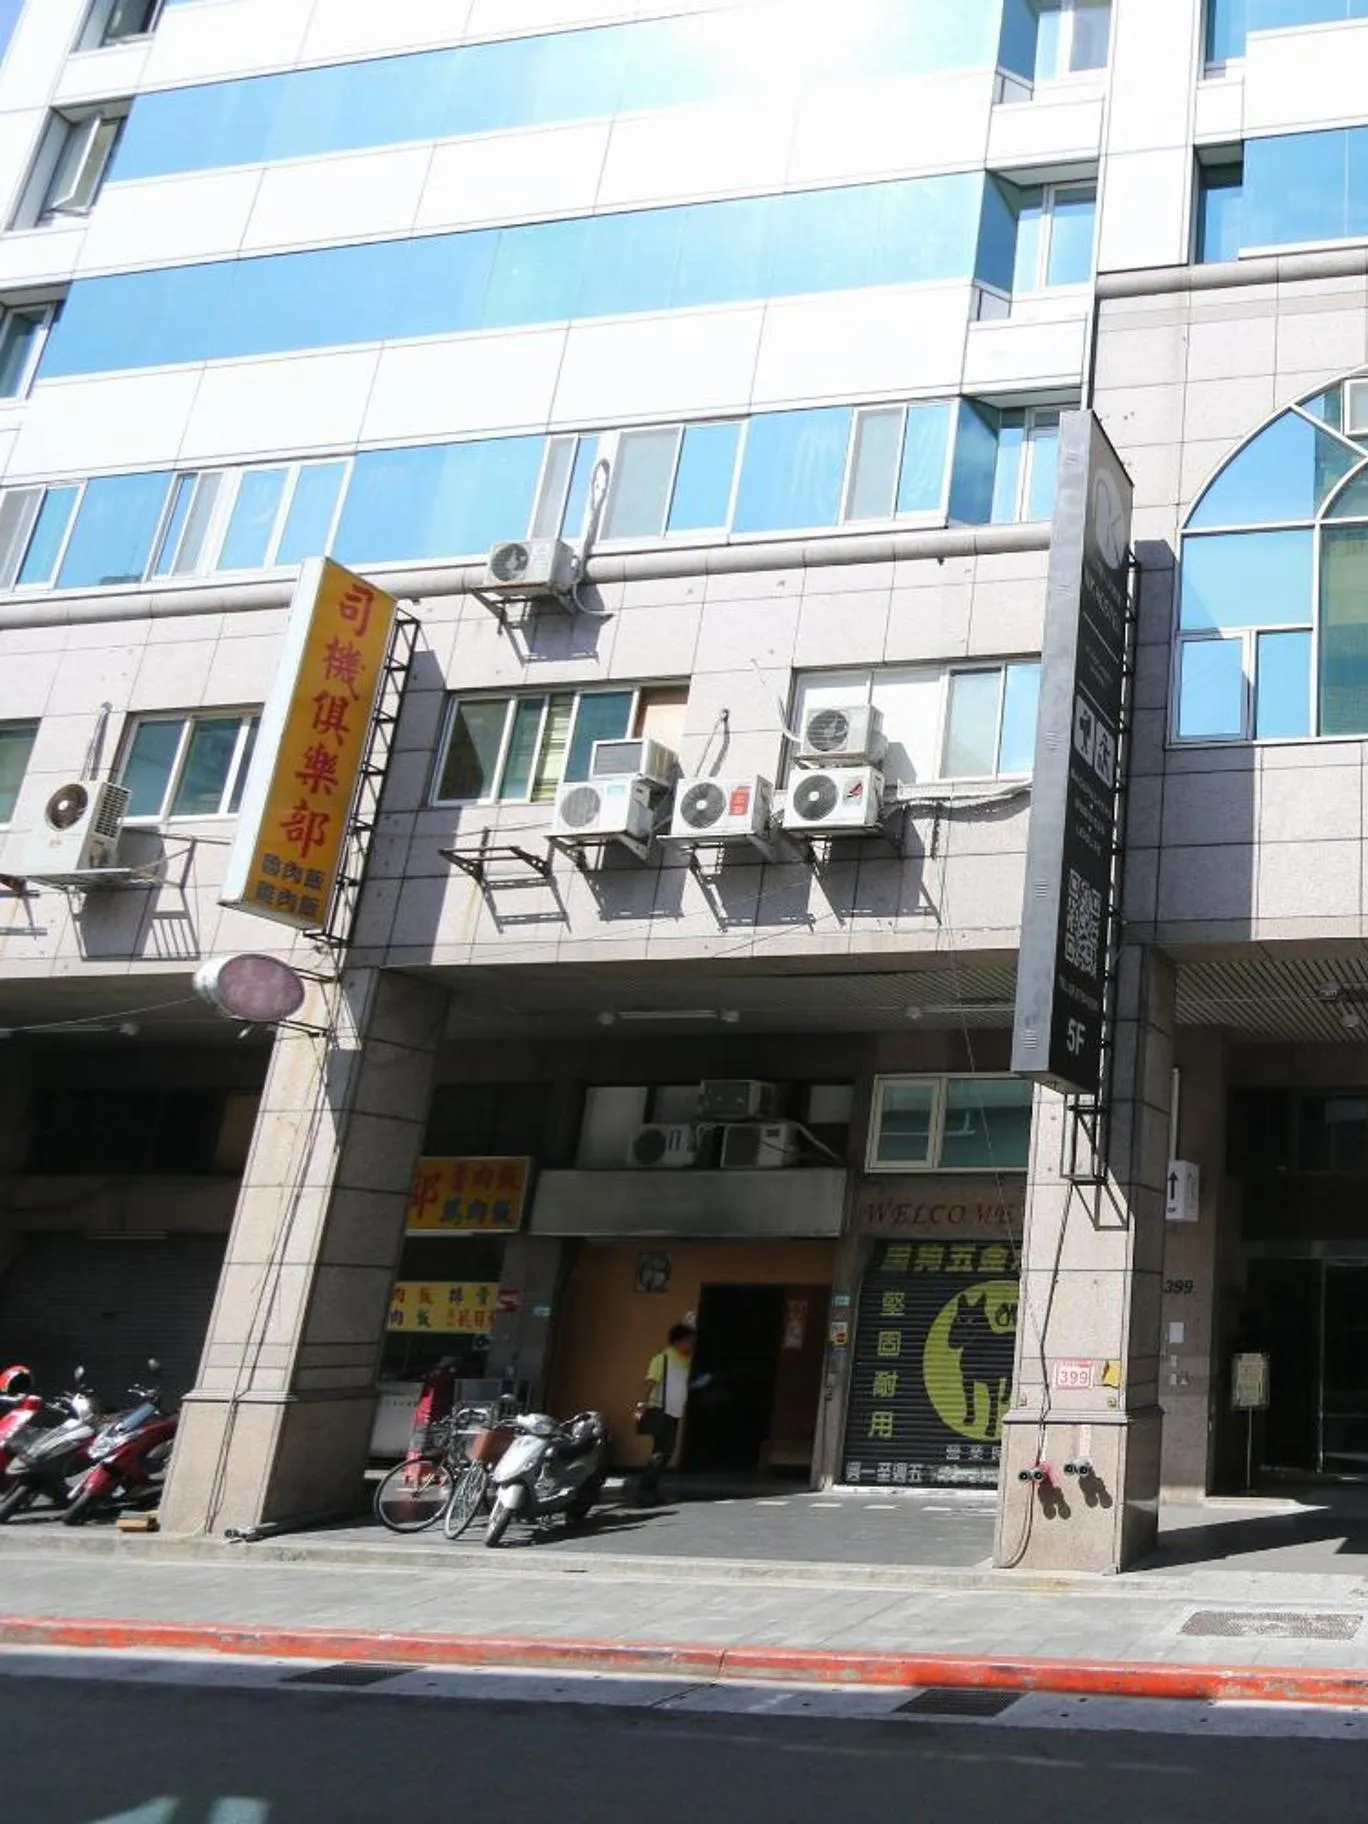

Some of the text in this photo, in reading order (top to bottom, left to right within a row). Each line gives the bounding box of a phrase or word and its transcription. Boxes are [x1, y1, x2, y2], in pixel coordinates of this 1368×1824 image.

[279, 583, 375, 860] 司機俱樂部
[1066, 1017, 1087, 1057] 5F
[1164, 1279, 1194, 1295] 399
[1060, 1370, 1089, 1385] 399
